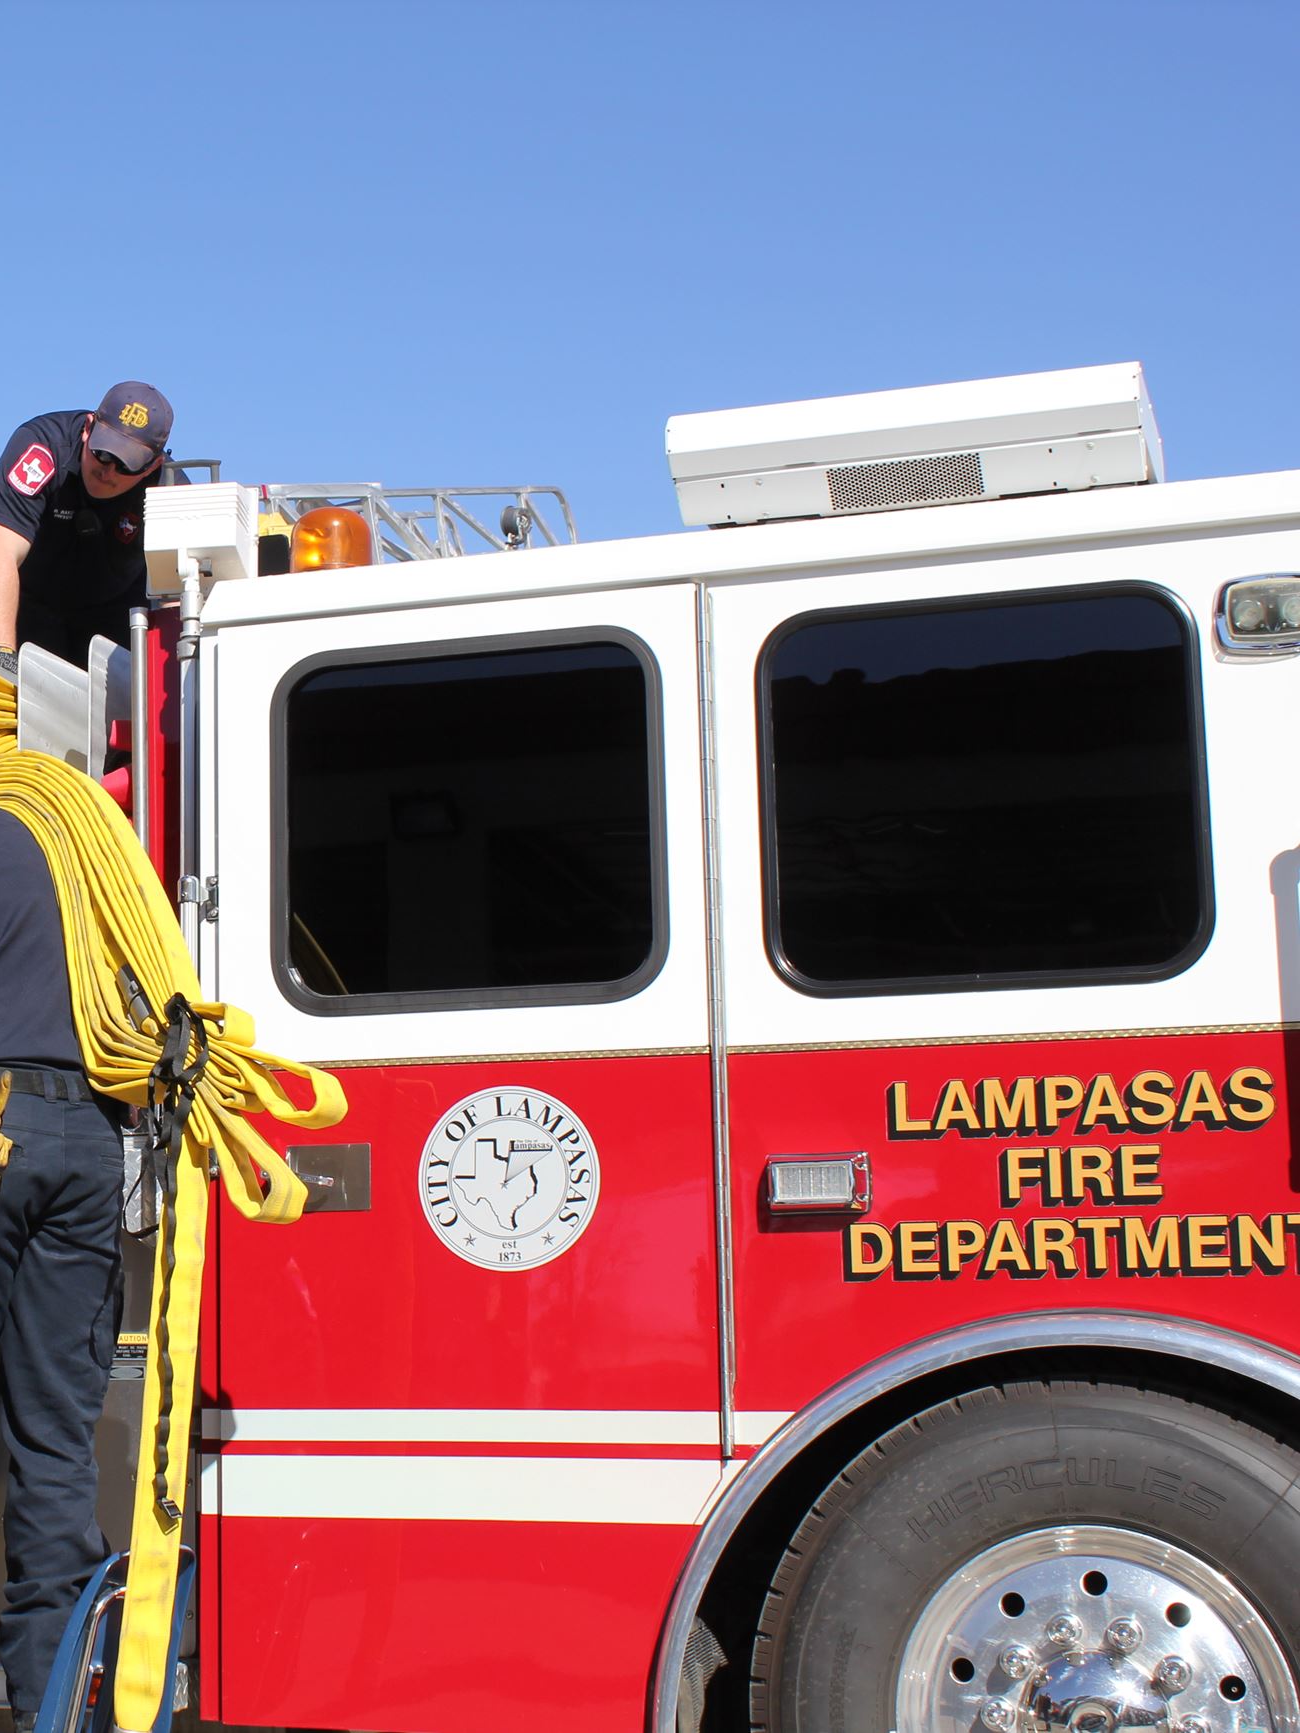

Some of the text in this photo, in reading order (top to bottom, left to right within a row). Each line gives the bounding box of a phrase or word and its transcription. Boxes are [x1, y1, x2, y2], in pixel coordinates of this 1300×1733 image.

[885, 1066, 1277, 1140] LAMPASAS
[428, 1096, 591, 1228] CITY OF LAMPASAS
[999, 1143, 1164, 1208] FIRE
[499, 1253, 521, 1262] 1873
[502, 1241, 517, 1249] est
[907, 1458, 1227, 1543] HERCULES
